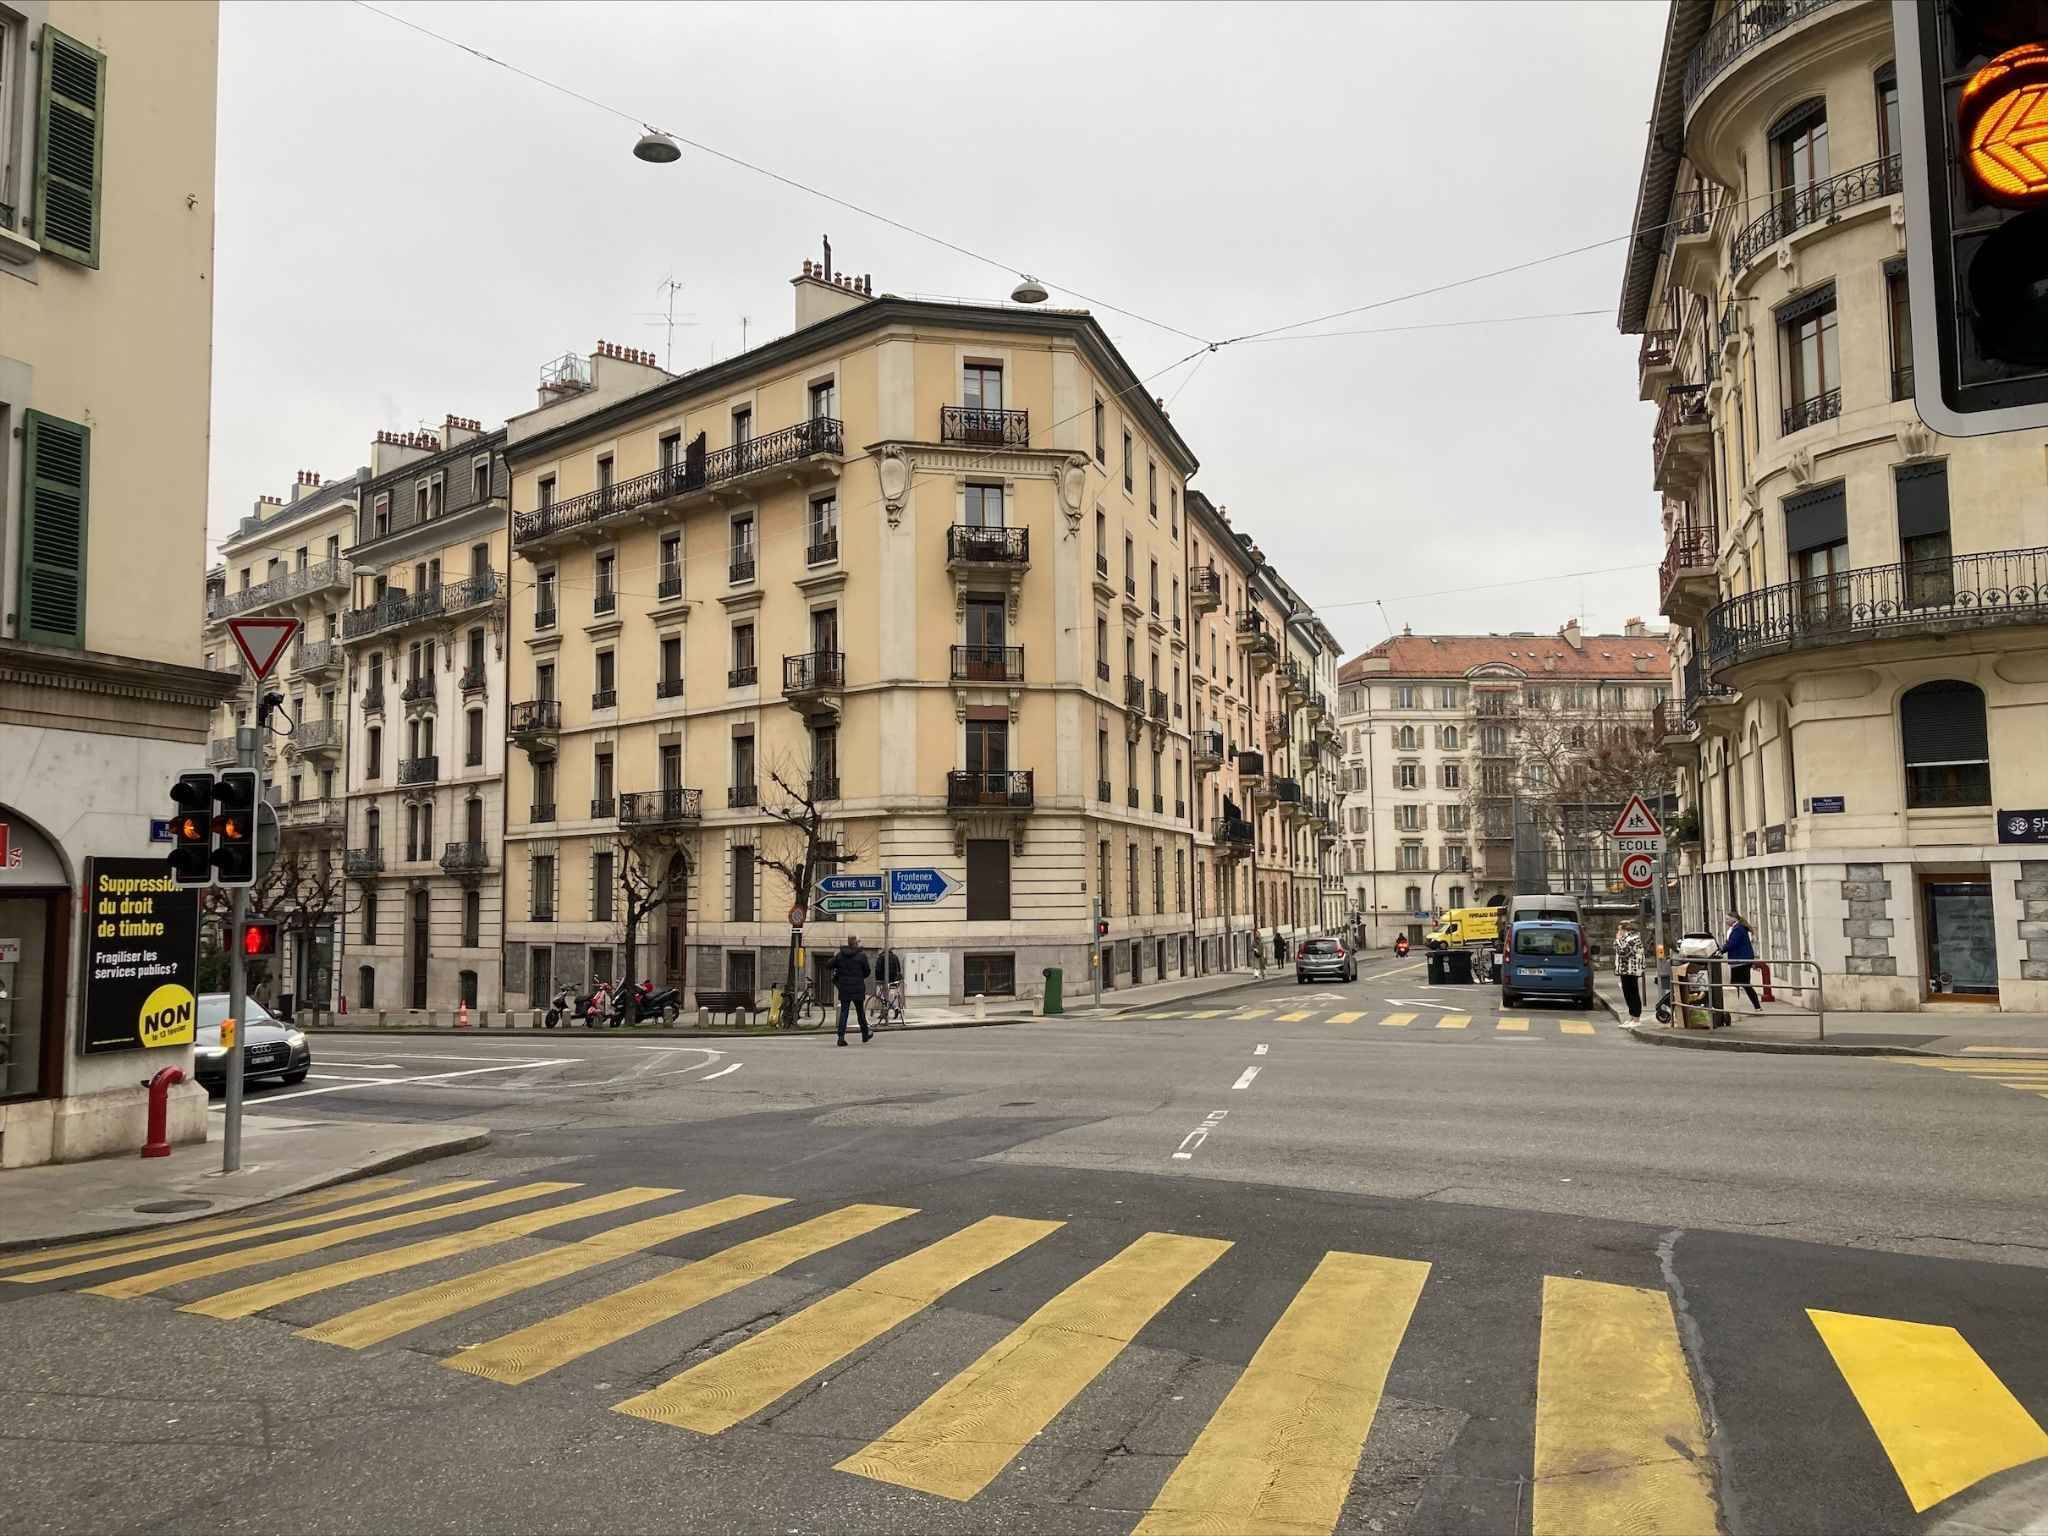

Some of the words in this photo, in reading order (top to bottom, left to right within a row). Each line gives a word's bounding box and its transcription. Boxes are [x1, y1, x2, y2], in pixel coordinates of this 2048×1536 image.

[1618, 840, 1658, 851] ECOLE
[896, 872, 932, 881] Frontenex
[1632, 865, 1647, 877] 40
[99, 874, 183, 896] Suppressio
[831, 880, 857, 889] CENTRE
[859, 879, 876, 888] VILLE
[900, 882, 929, 892] Cologny
[99, 897, 116, 915] du
[120, 897, 153, 914] droit
[97, 920, 116, 938] de
[119, 919, 165, 937] timbre
[96, 950, 141, 965] Fragiliser
[143, 949, 158, 961] les
[95, 966, 136, 979] services
[138, 962, 178, 979] publics?
[144, 1001, 191, 1035] NON
